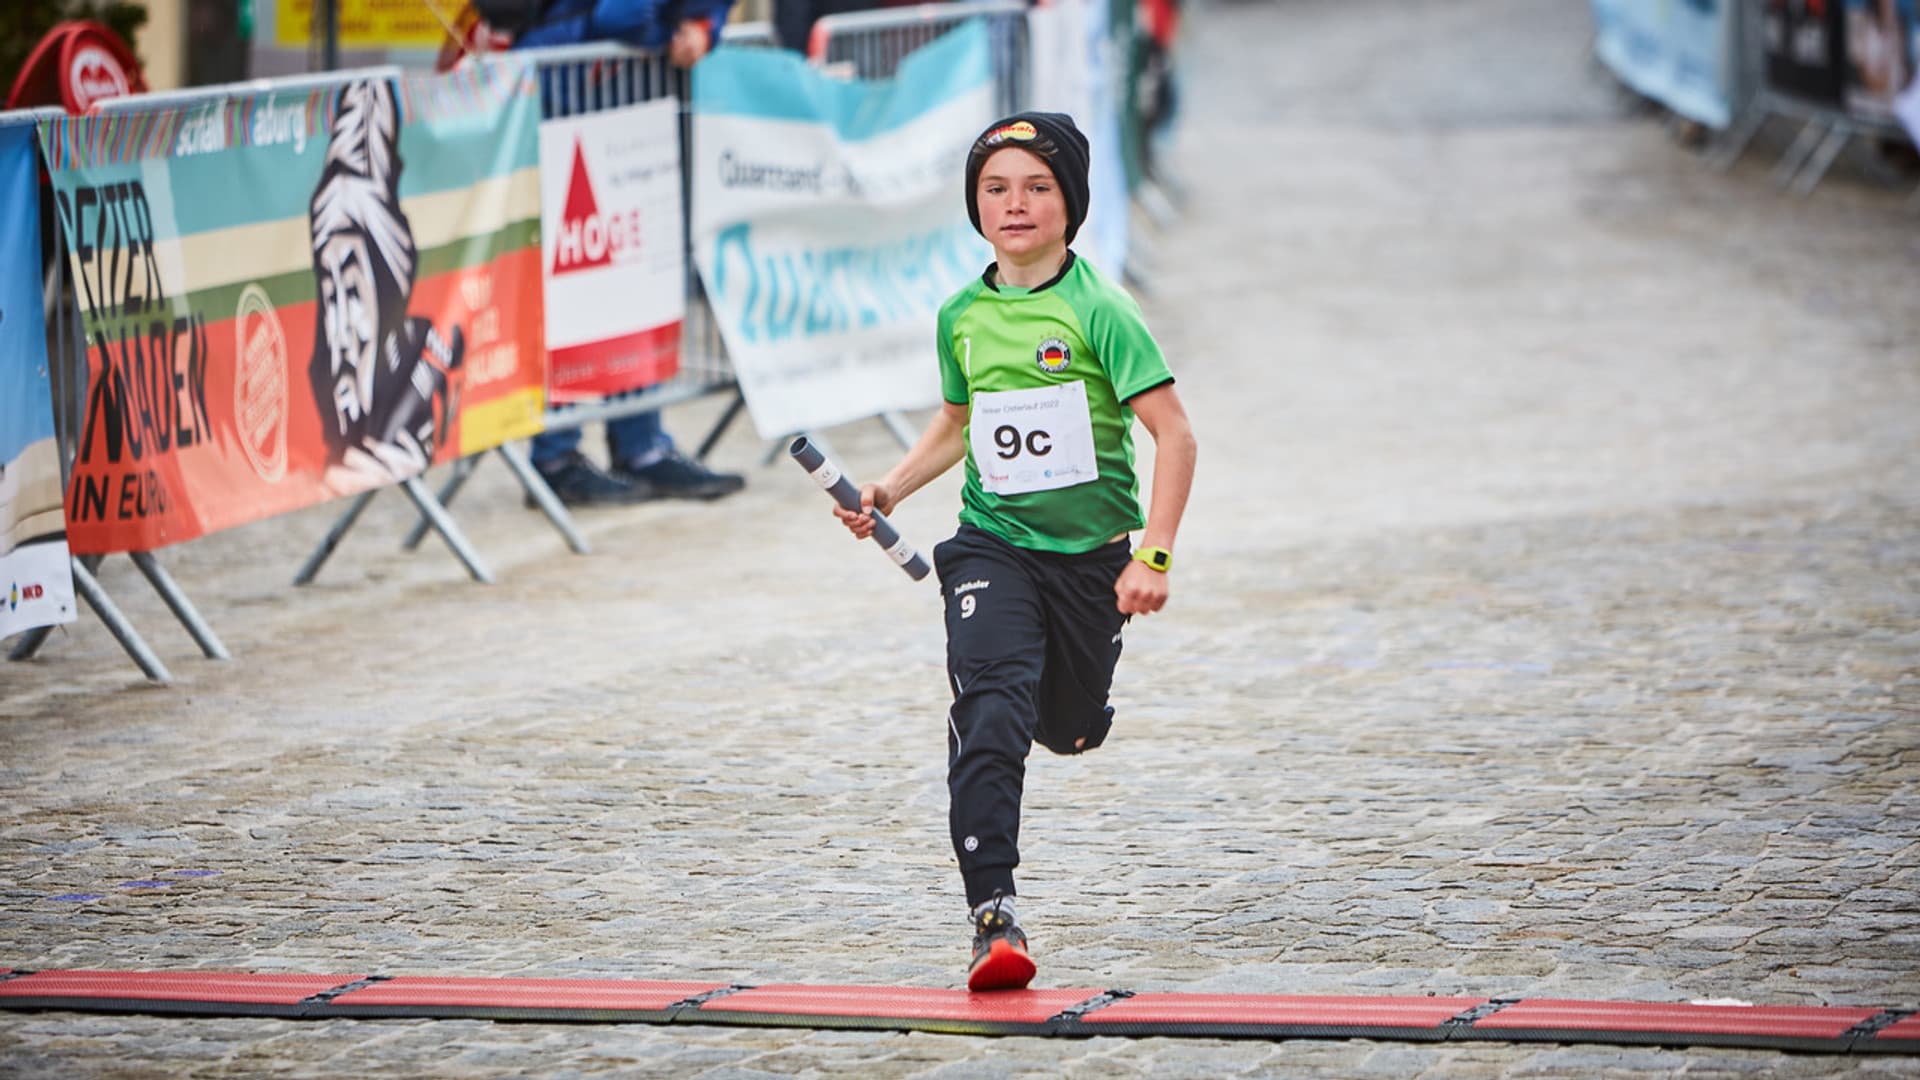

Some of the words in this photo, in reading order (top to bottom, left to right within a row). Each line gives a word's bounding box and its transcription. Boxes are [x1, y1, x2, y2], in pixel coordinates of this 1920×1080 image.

[993, 424, 1052, 460] 9c
[70, 472, 109, 523] IN
[960, 594, 976, 620] 9
